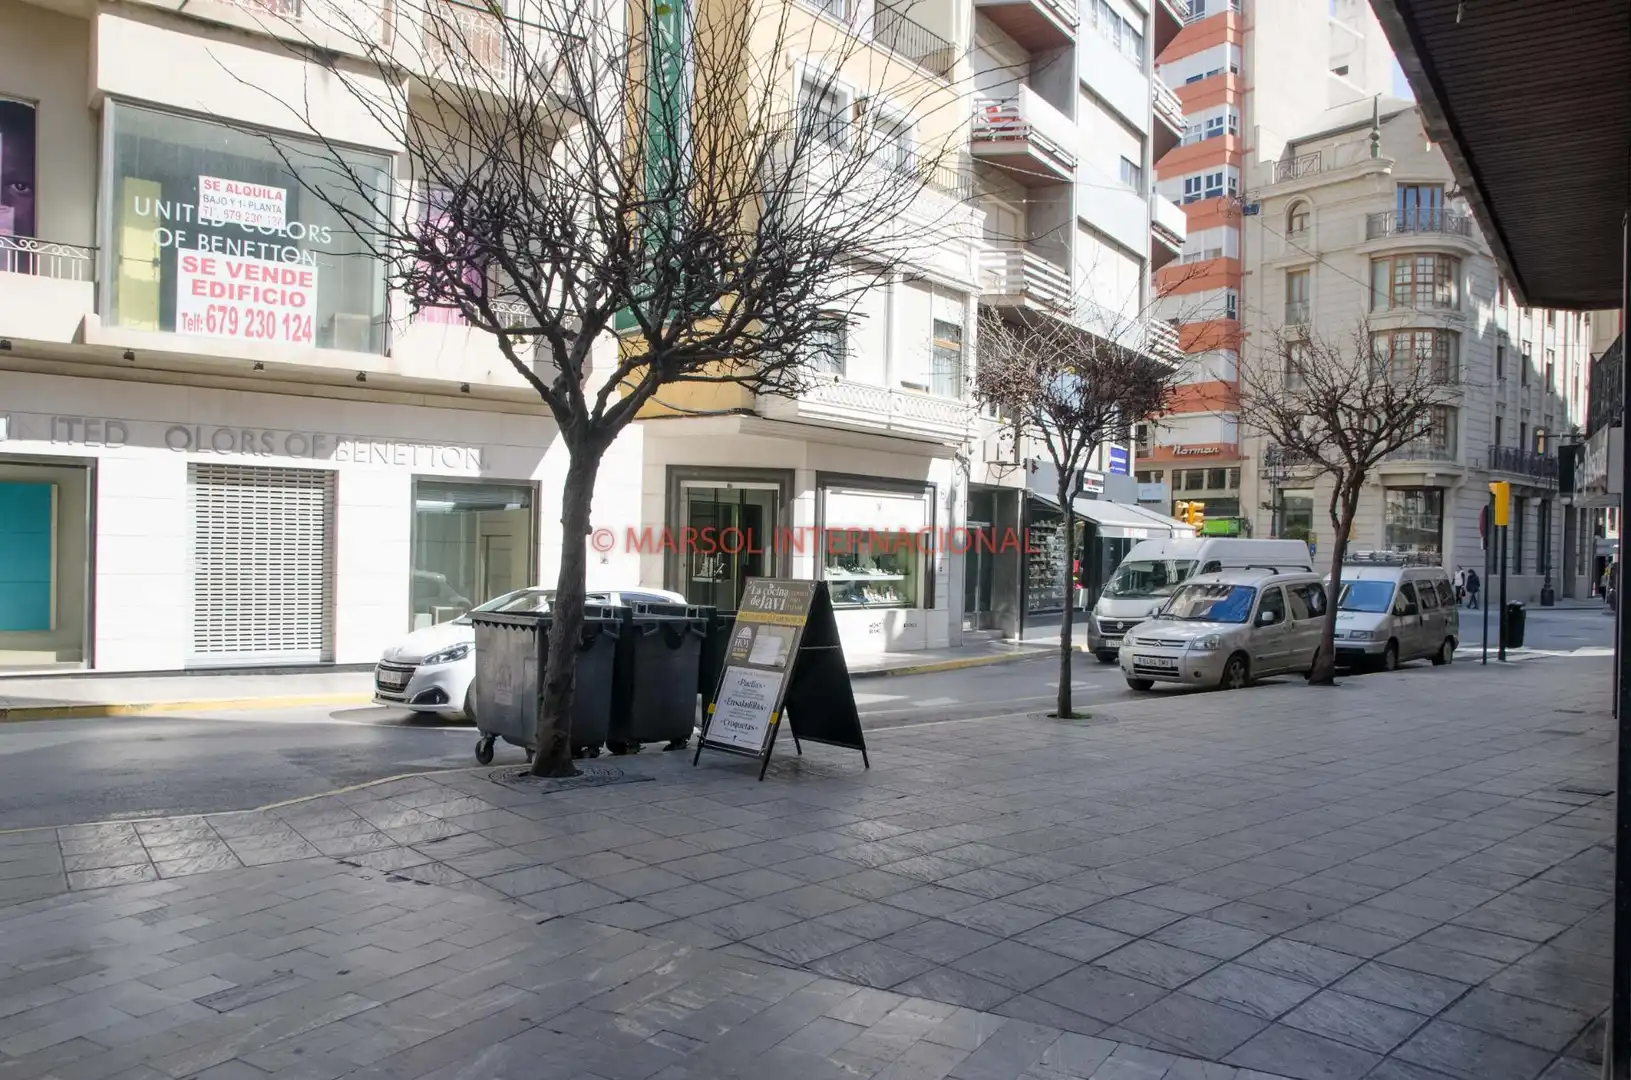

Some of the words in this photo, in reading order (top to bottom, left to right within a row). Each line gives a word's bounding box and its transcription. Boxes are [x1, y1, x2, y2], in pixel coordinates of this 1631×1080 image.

[203, 179, 221, 192] SE
[225, 182, 284, 201] ALQUILA
[203, 194, 228, 205] BAJO
[248, 201, 282, 214] PLANTA
[153, 227, 187, 248] OF
[198, 233, 317, 266] BENETTON
[182, 255, 216, 276] SE
[226, 261, 313, 288] VENDE
[191, 278, 306, 308] EDIFICIO
[206, 304, 239, 336] 679
[244, 308, 276, 340] 230
[282, 312, 313, 343] 124
[284, 432, 327, 458] OF
[1172, 444, 1220, 456] Norman
